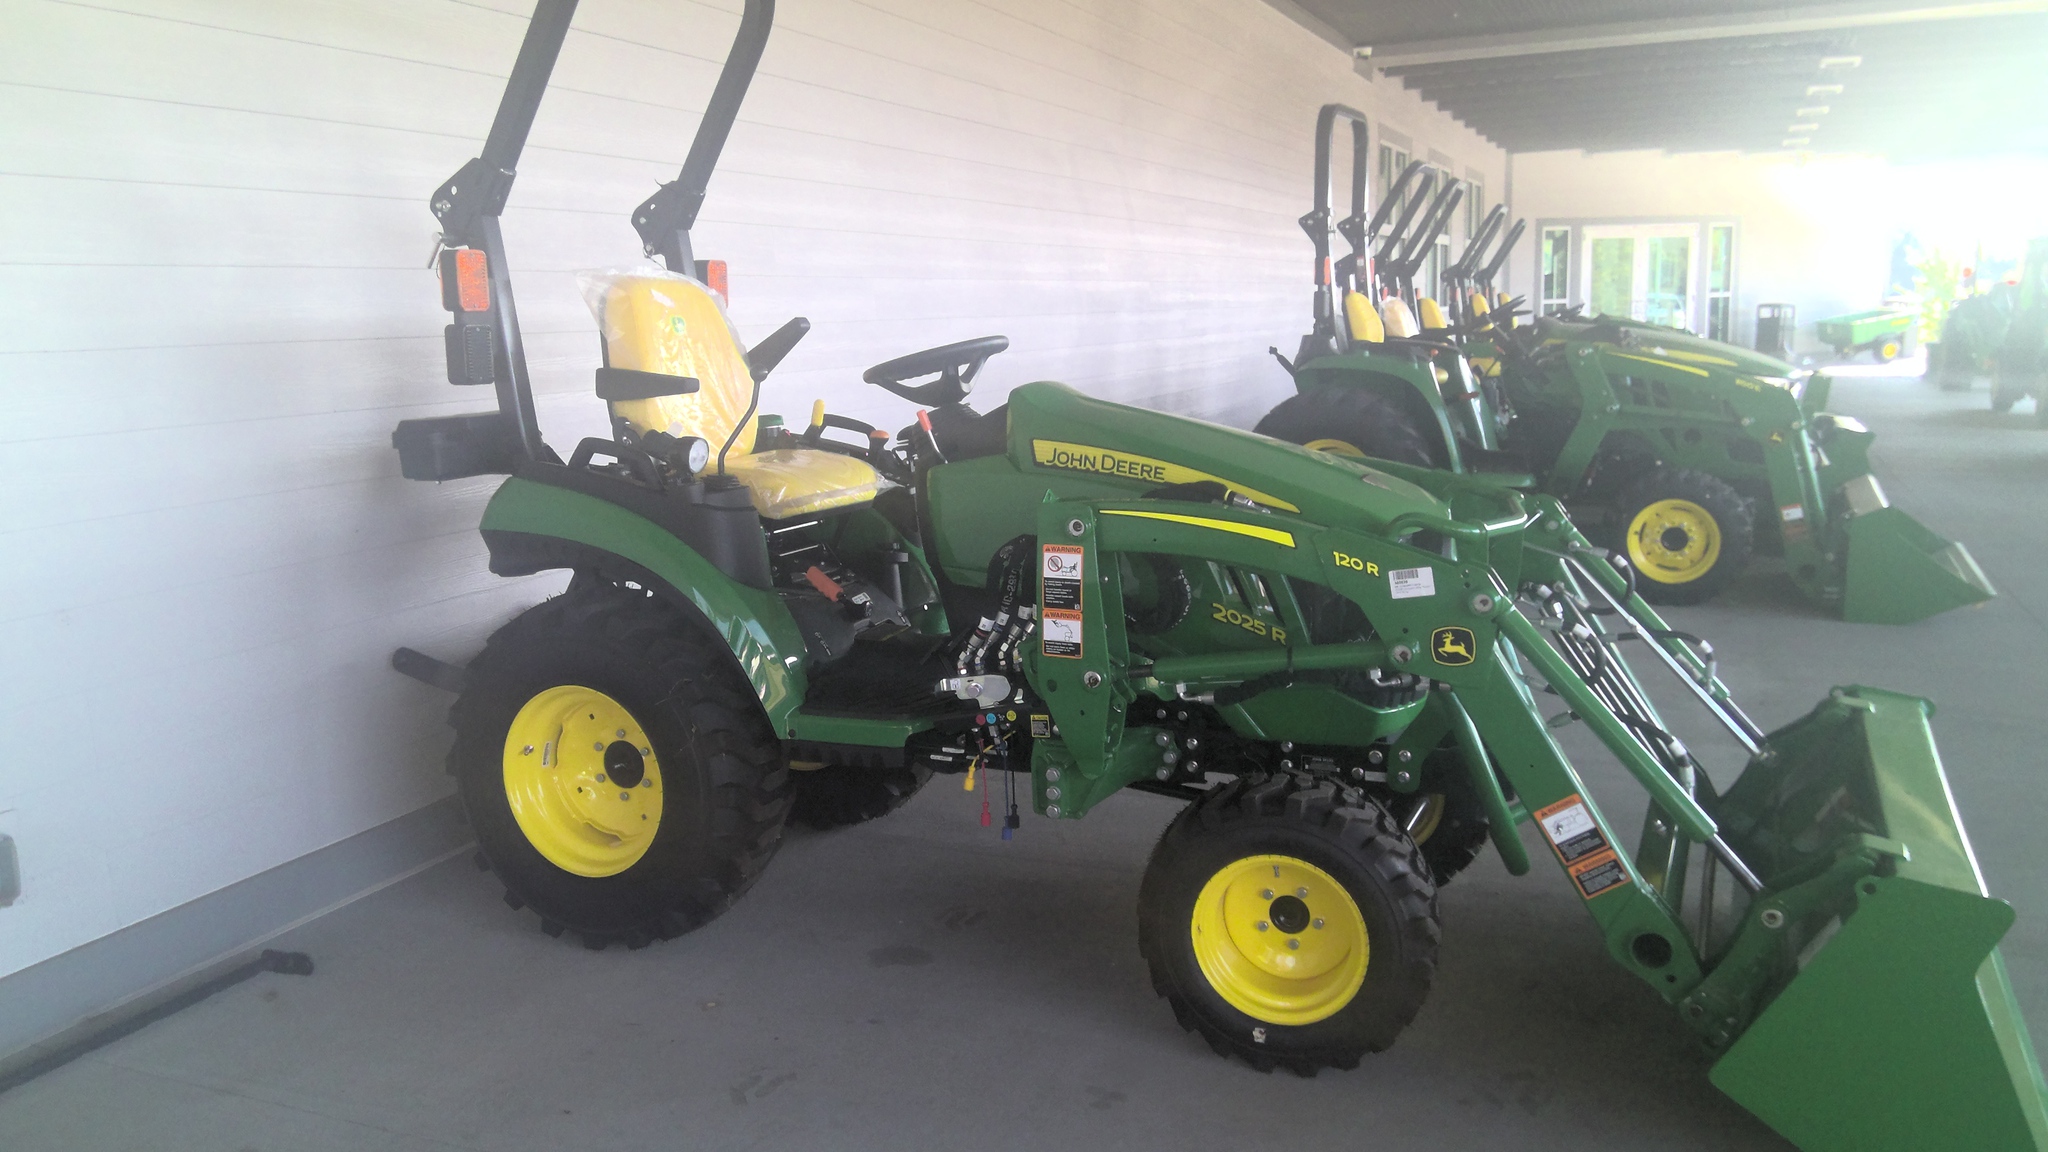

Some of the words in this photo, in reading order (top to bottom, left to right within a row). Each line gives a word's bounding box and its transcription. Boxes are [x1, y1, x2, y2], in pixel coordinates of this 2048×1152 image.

[1045, 447, 1096, 470] JOHN
[1101, 454, 1166, 481] DEERE
[1051, 545, 1081, 553] WARNING
[1333, 551, 1363, 571] 120
[1367, 561, 1379, 577] R
[1050, 612, 1080, 620] WARNING
[1212, 603, 1266, 636] 2025
[1271, 627, 1287, 645] R
